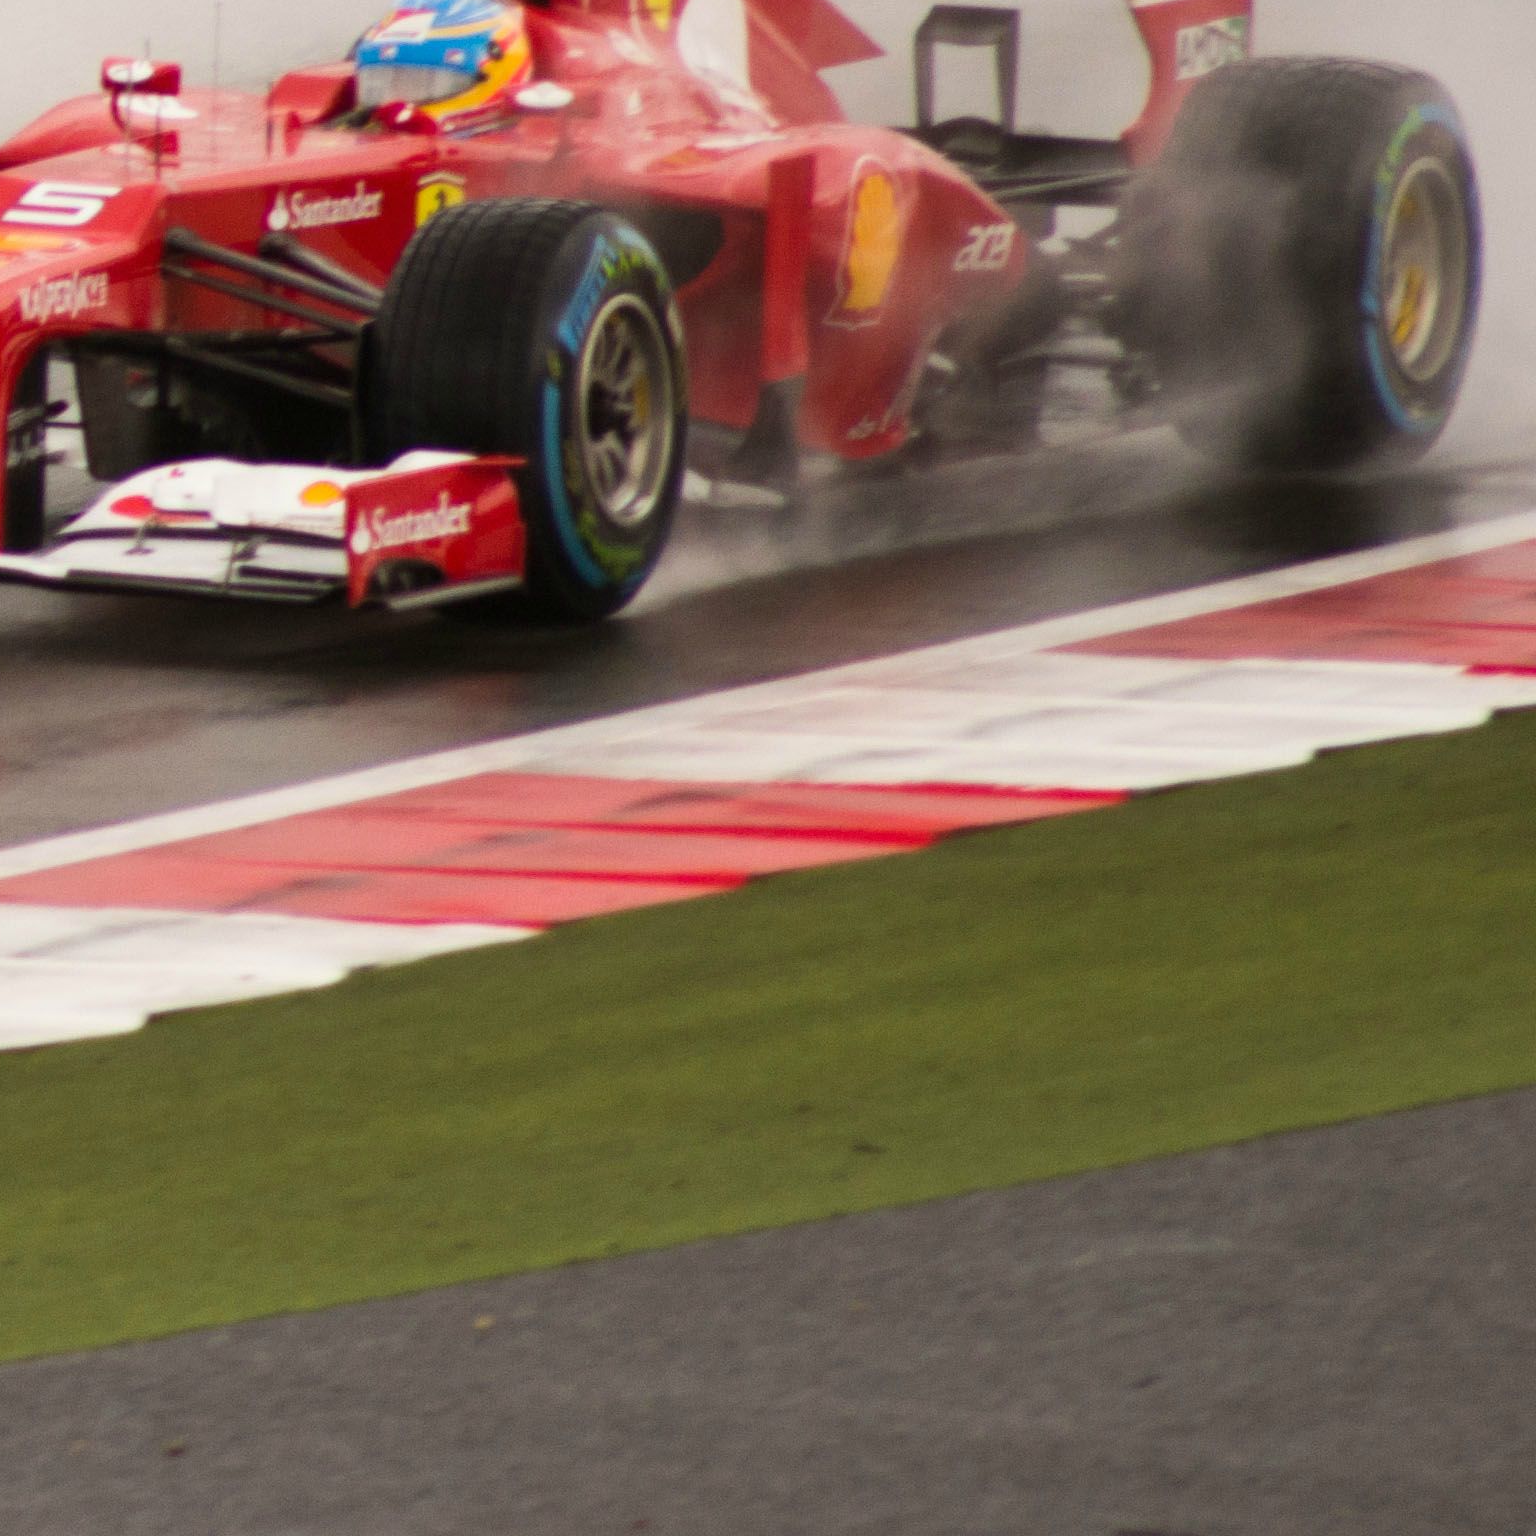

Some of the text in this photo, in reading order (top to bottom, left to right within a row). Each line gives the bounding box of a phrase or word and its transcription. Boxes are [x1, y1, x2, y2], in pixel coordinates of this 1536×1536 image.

[1, 180, 123, 227] 5
[289, 180, 384, 230] Santander
[372, 490, 472, 551] Santander
